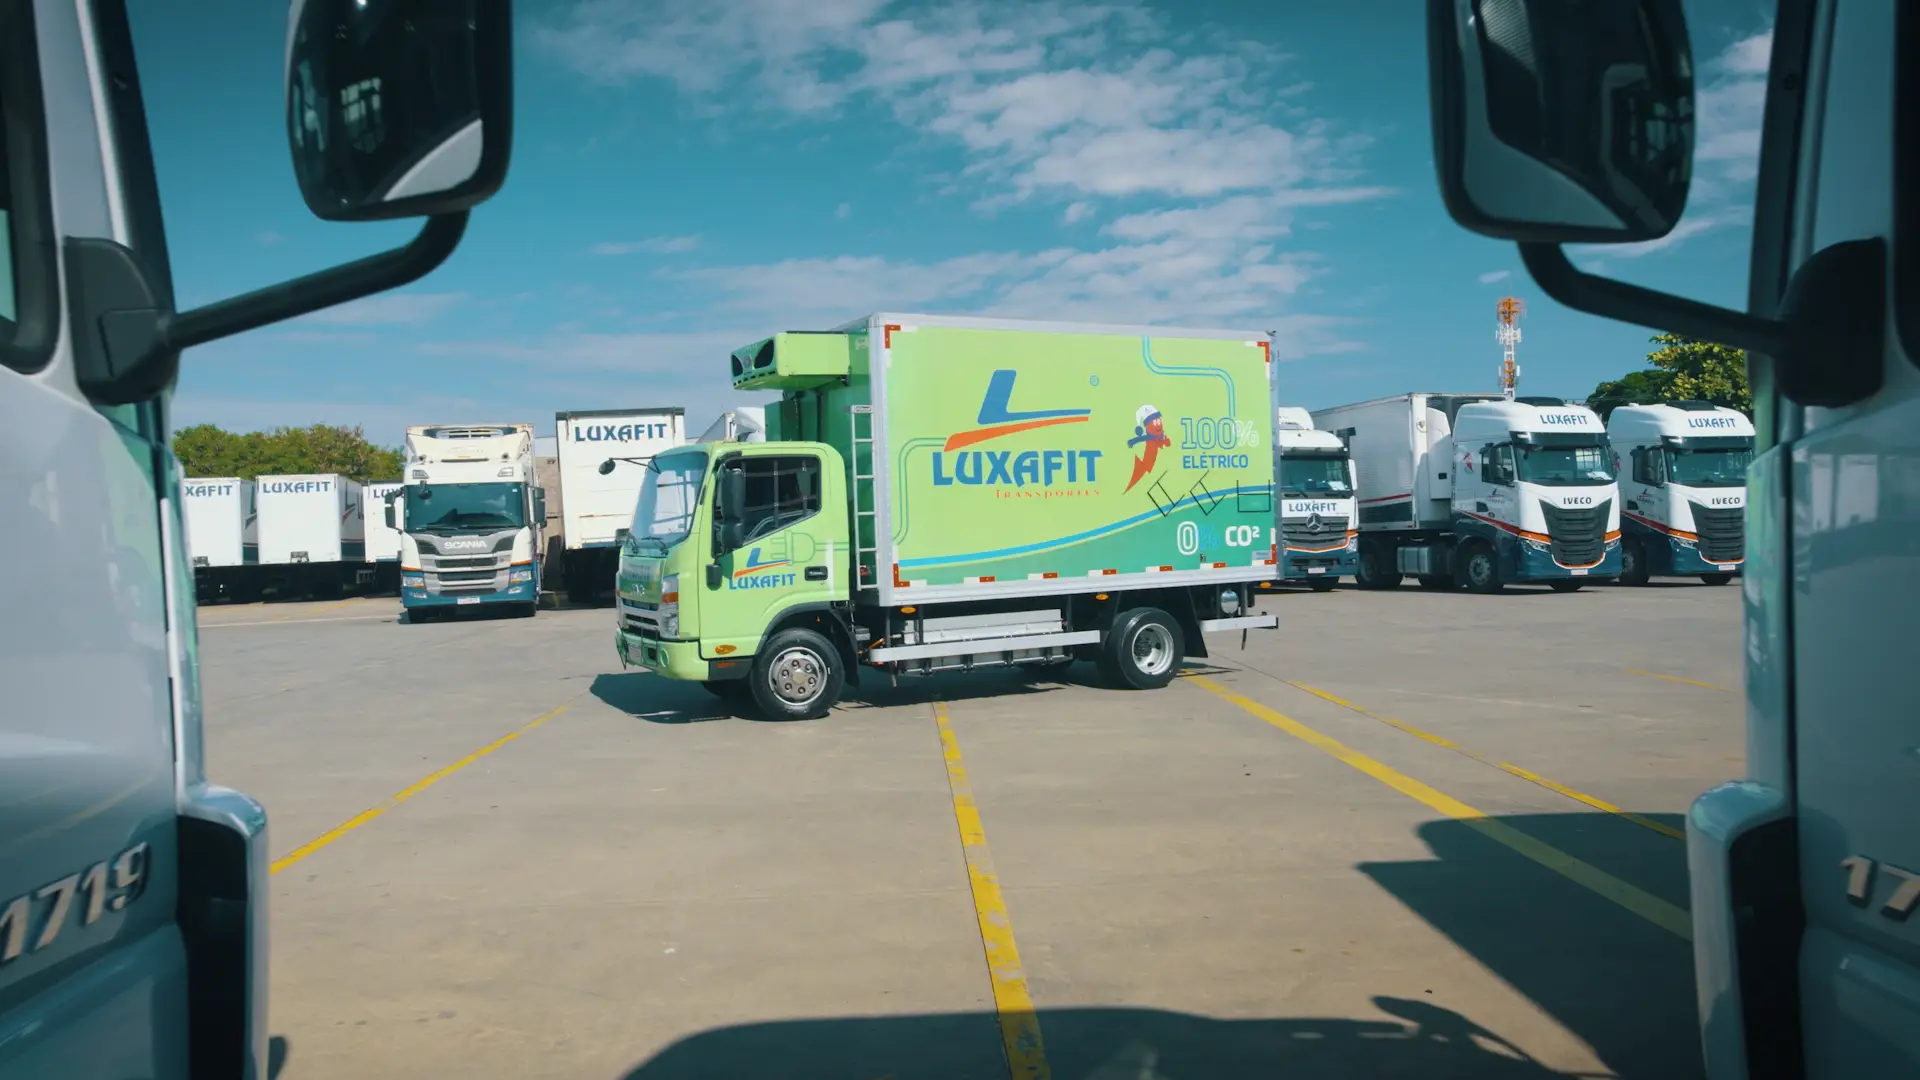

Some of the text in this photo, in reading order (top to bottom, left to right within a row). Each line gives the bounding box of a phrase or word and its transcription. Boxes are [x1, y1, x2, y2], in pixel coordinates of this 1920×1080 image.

[1540, 414, 1588, 426] LUXAFIT
[1688, 417, 1736, 429] LUXAFIT
[575, 423, 668, 442] LUXAFIT
[1181, 417, 1259, 450] 100%
[1183, 452, 1248, 469] ELÉTRICO
[932, 450, 1102, 487] LUXAFIT
[185, 485, 233, 497] XAFIT
[262, 481, 331, 494] LUXAFIT
[1289, 502, 1337, 511] LUXAFIT
[1563, 496, 1592, 505] IVECO
[1711, 496, 1741, 505] IVECO
[444, 540, 487, 549] SCANIA
[729, 574, 796, 589] LUXAFIT
[0, 842, 148, 961] 1719
